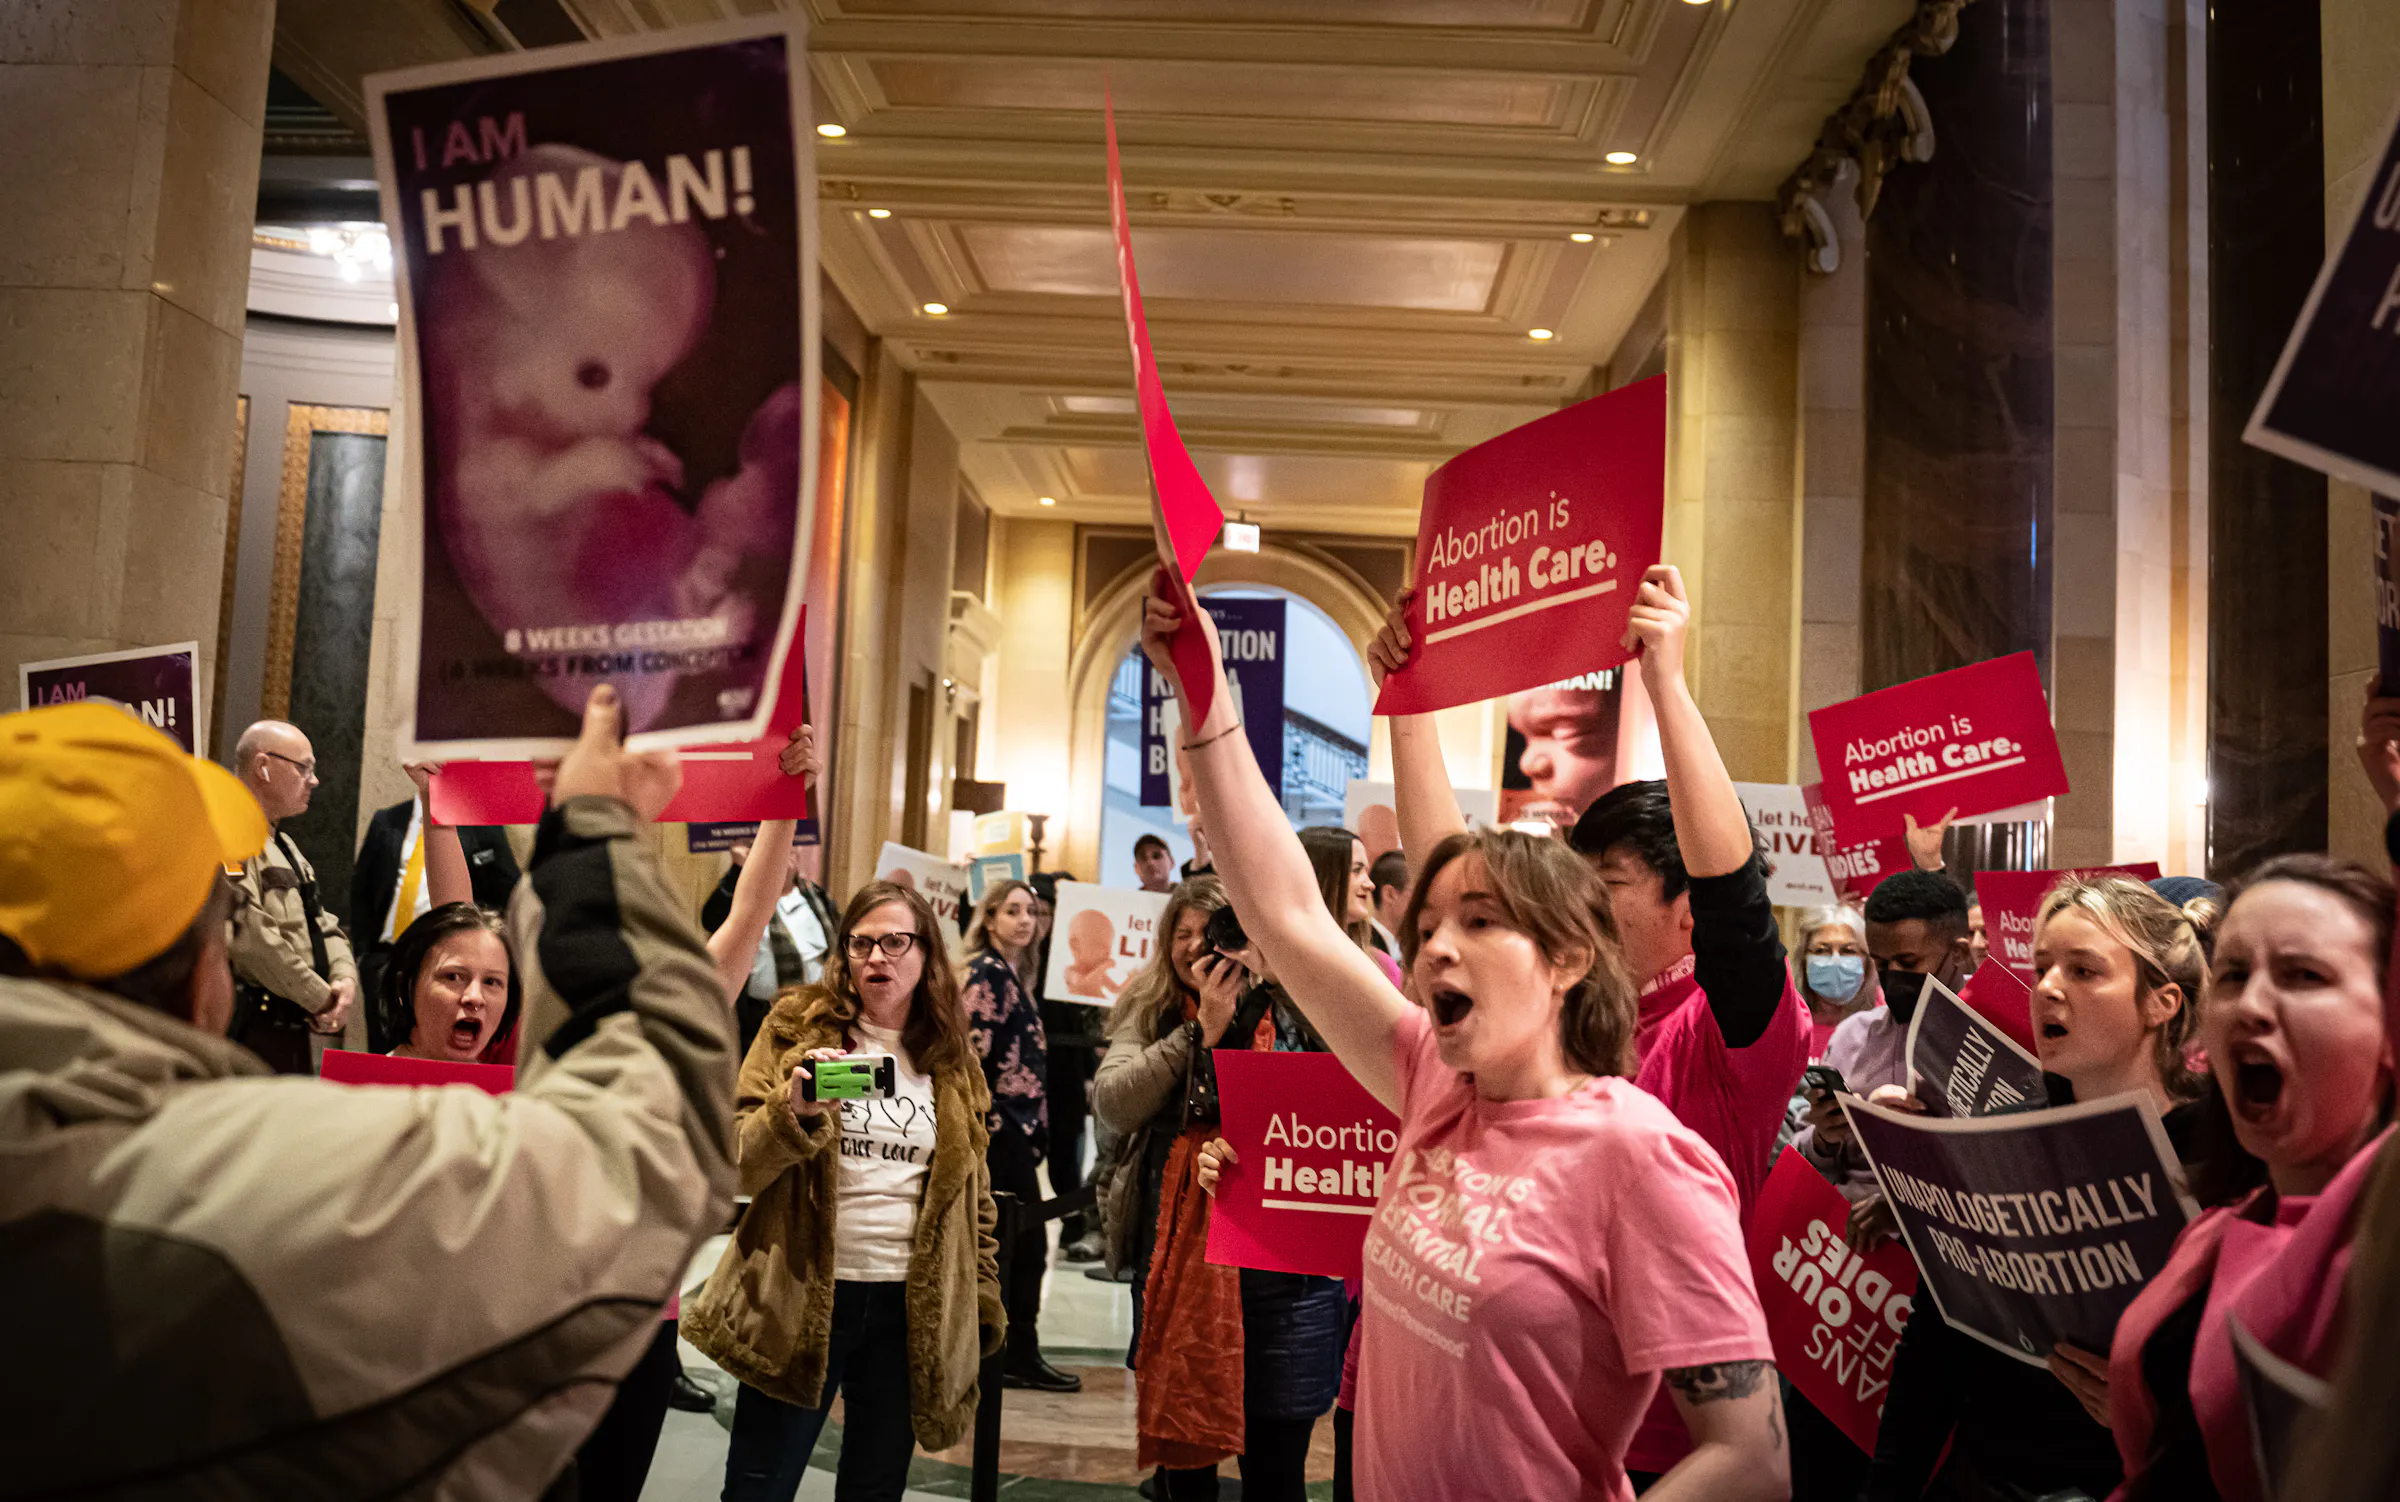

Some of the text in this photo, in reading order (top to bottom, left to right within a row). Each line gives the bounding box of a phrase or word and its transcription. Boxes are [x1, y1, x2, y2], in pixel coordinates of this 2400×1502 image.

[412, 111, 529, 171] I AM
[421, 146, 755, 255] HUMAN!
[1427, 491, 1570, 574] Abortion is
[1426, 539, 1617, 625] Health Care.
[526, 622, 610, 651] WEEKS
[1219, 629, 1276, 661] TION
[50, 681, 86, 705] AM
[1845, 714, 1973, 767] Abortion is
[1848, 737, 2022, 794] Health Care.
[1758, 809, 1812, 827] let he
[1773, 831, 1821, 856] IV
[1119, 935, 1149, 959] LI
[1128, 914, 1152, 932] let
[2000, 909, 2036, 933] Abor
[1263, 1112, 1398, 1154] Abortio
[1881, 1163, 2158, 1238] UNAPOLOGETICALLY
[1370, 1237, 1416, 1291] EALTH
[1416, 1274, 1472, 1323] CARE
[1772, 1235, 1852, 1328] OUR
[1800, 1219, 1916, 1335] ODIES
[1927, 1225, 2143, 1296] PRO-ABORTION
[1803, 1323, 1889, 1403] ANS
[1845, 1320, 1902, 1371] FF
